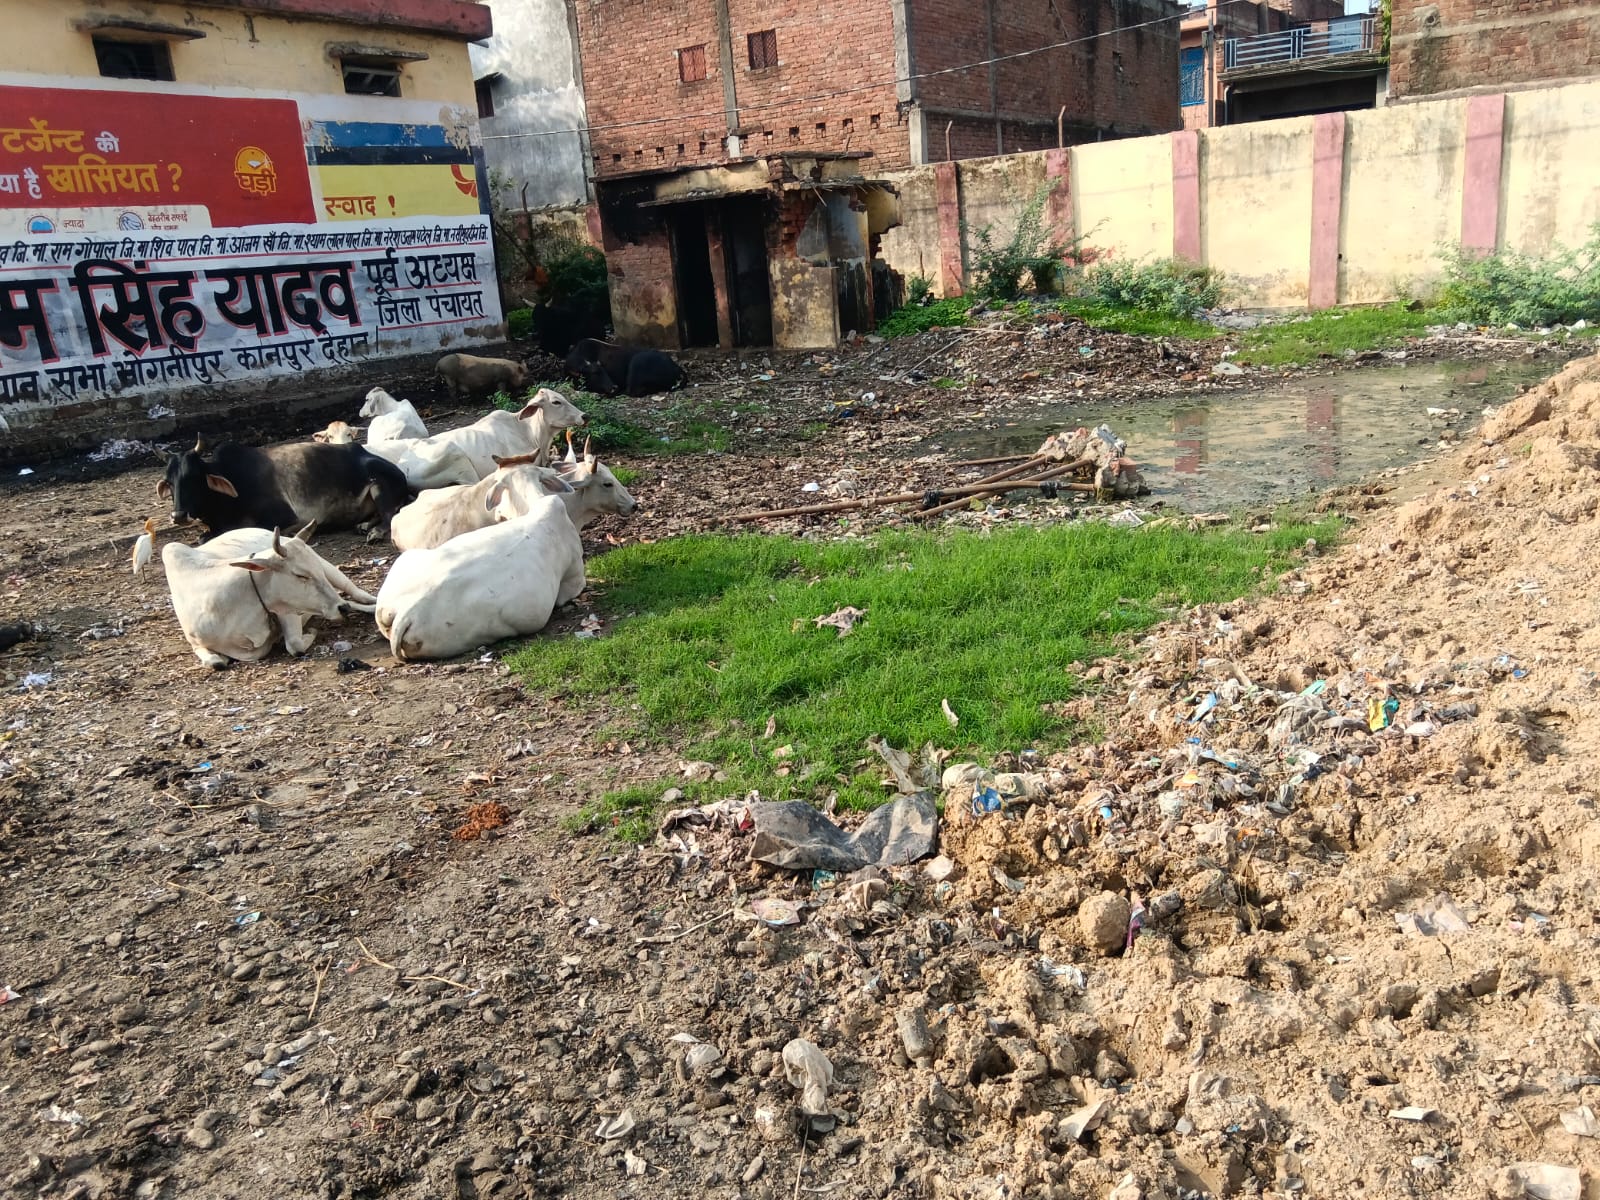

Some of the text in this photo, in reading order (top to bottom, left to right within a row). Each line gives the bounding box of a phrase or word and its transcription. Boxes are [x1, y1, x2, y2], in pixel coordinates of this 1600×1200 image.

[0, 117, 119, 153] टर्जेन्ट की
[0, 174, 20, 193] या
[23, 167, 42, 199] है
[43, 153, 160, 195] खासियत
[234, 168, 277, 196] घड़ी
[322, 196, 376, 216] स्वाद
[50, 242, 74, 263] राम
[75, 237, 118, 261] गोपाल
[361, 247, 399, 297] पूर्व
[0, 258, 362, 364] म सिंह यादव
[374, 289, 484, 326] जिला पंचायत
[45, 364, 106, 400] सभा
[231, 339, 315, 371] कानपुर
